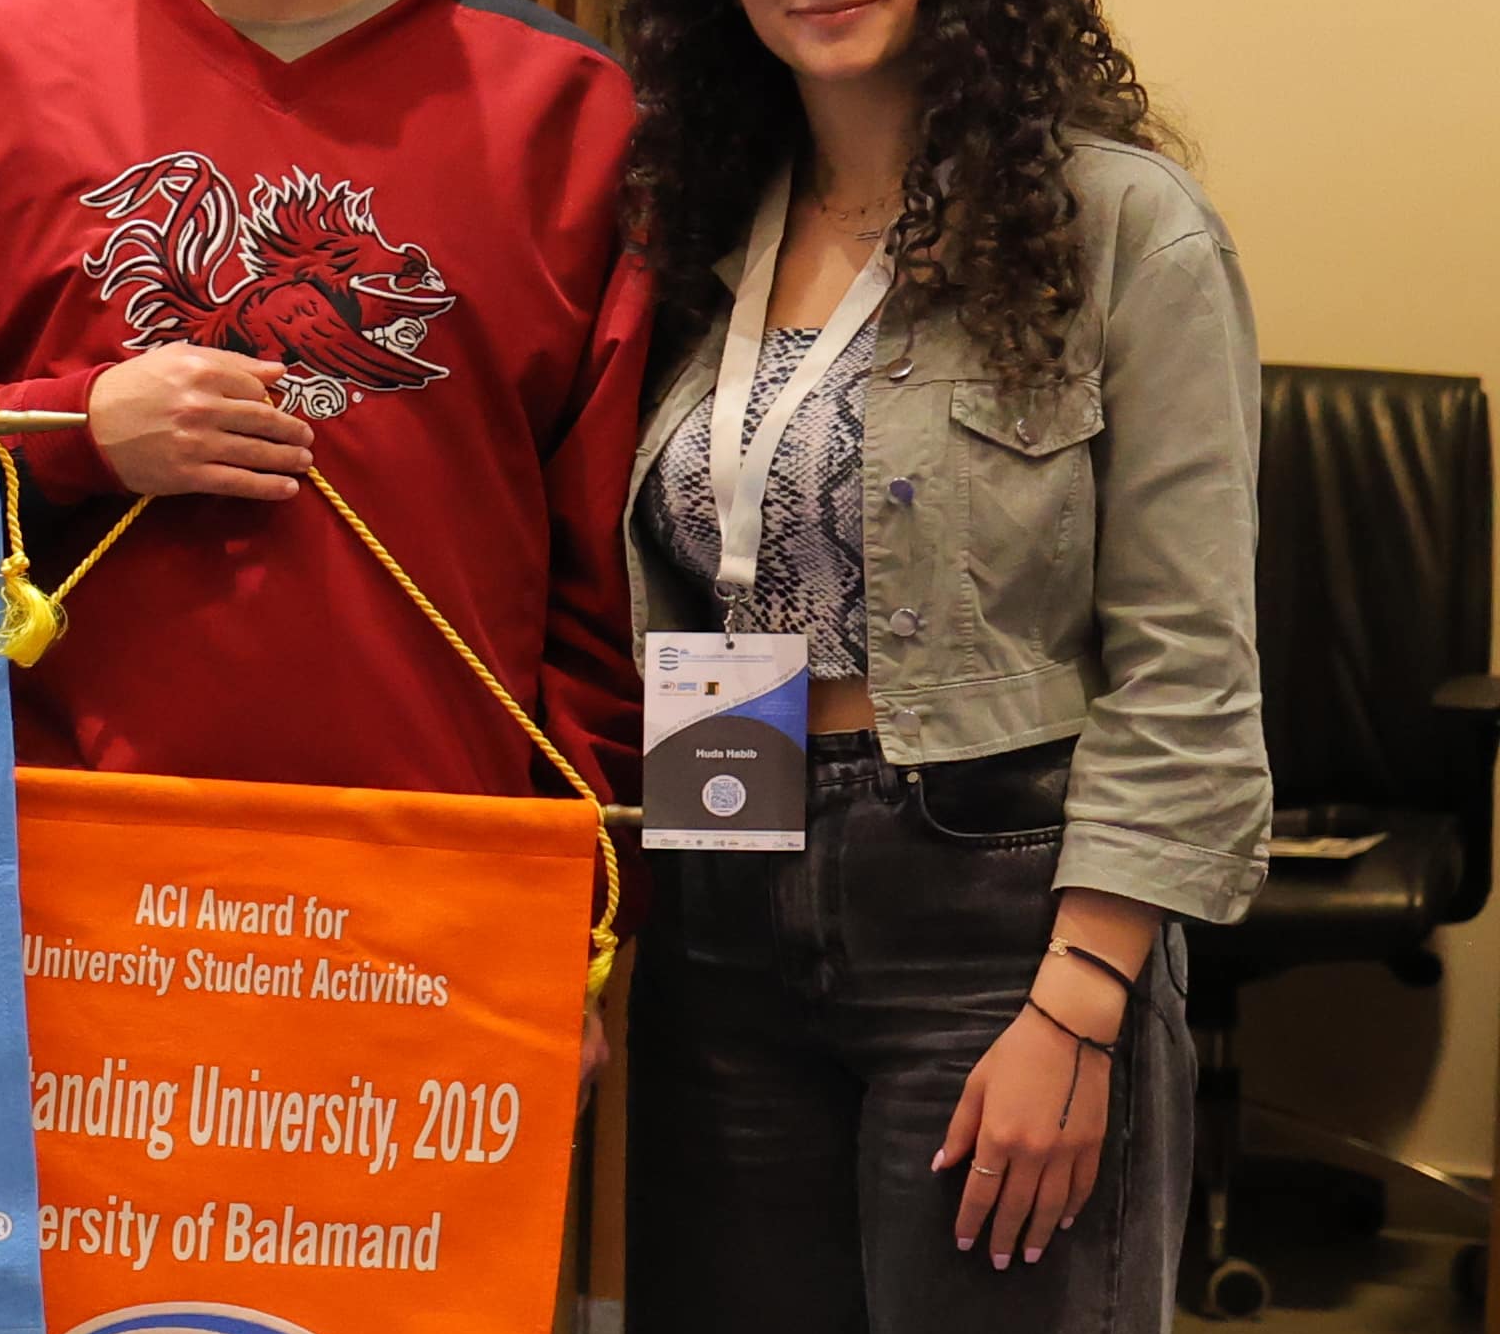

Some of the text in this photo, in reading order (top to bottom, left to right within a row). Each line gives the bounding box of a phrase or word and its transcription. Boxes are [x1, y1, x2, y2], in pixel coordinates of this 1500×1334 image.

[135, 883, 350, 941] ACI Award for
[22, 934, 449, 1007] University Student Activities
[189, 1065, 399, 1175] University,
[413, 1079, 521, 1164] 2019
[39, 1194, 442, 1273] ersity of Balamand
